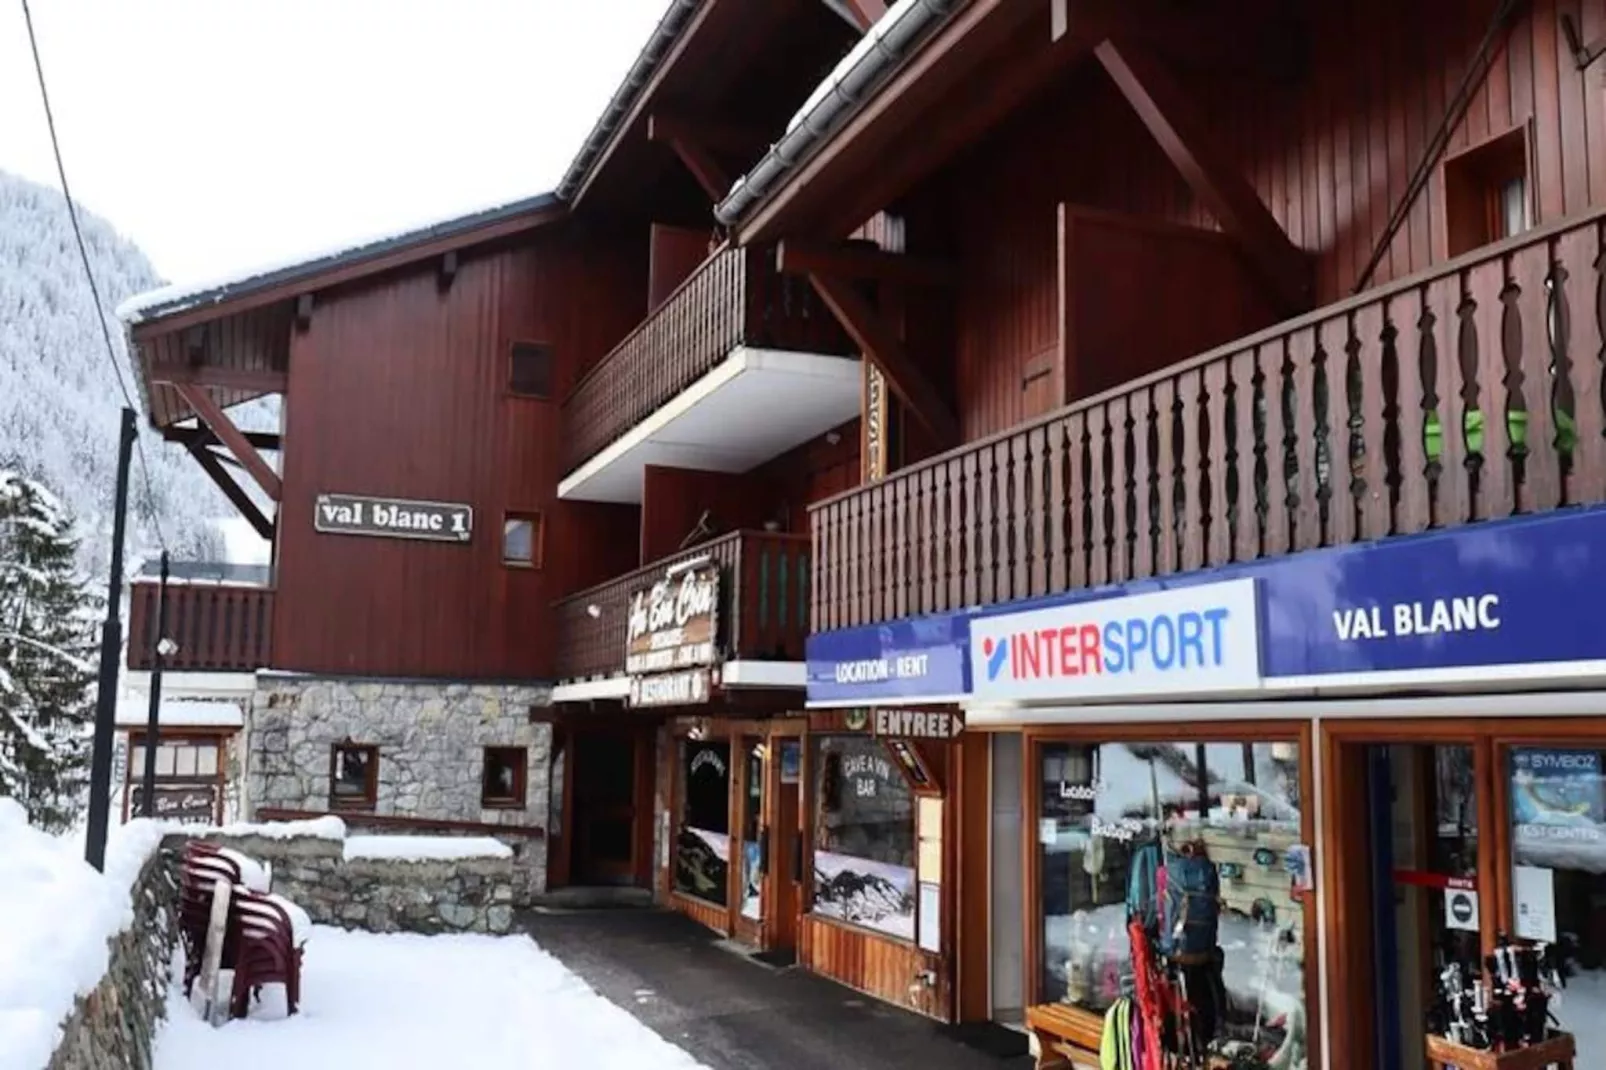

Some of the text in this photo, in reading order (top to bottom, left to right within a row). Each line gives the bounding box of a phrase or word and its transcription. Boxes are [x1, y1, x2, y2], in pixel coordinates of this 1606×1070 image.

[322, 503, 466, 532] val blanc 1
[1333, 594, 1500, 640] VAL BLANC
[1011, 607, 1229, 680] INTERSPORT
[836, 658, 888, 684] LOCATION
[896, 654, 928, 678] RENT
[876, 709, 949, 738] ENTREE
[844, 754, 867, 778] CAVE
[856, 777, 877, 797] BAR
